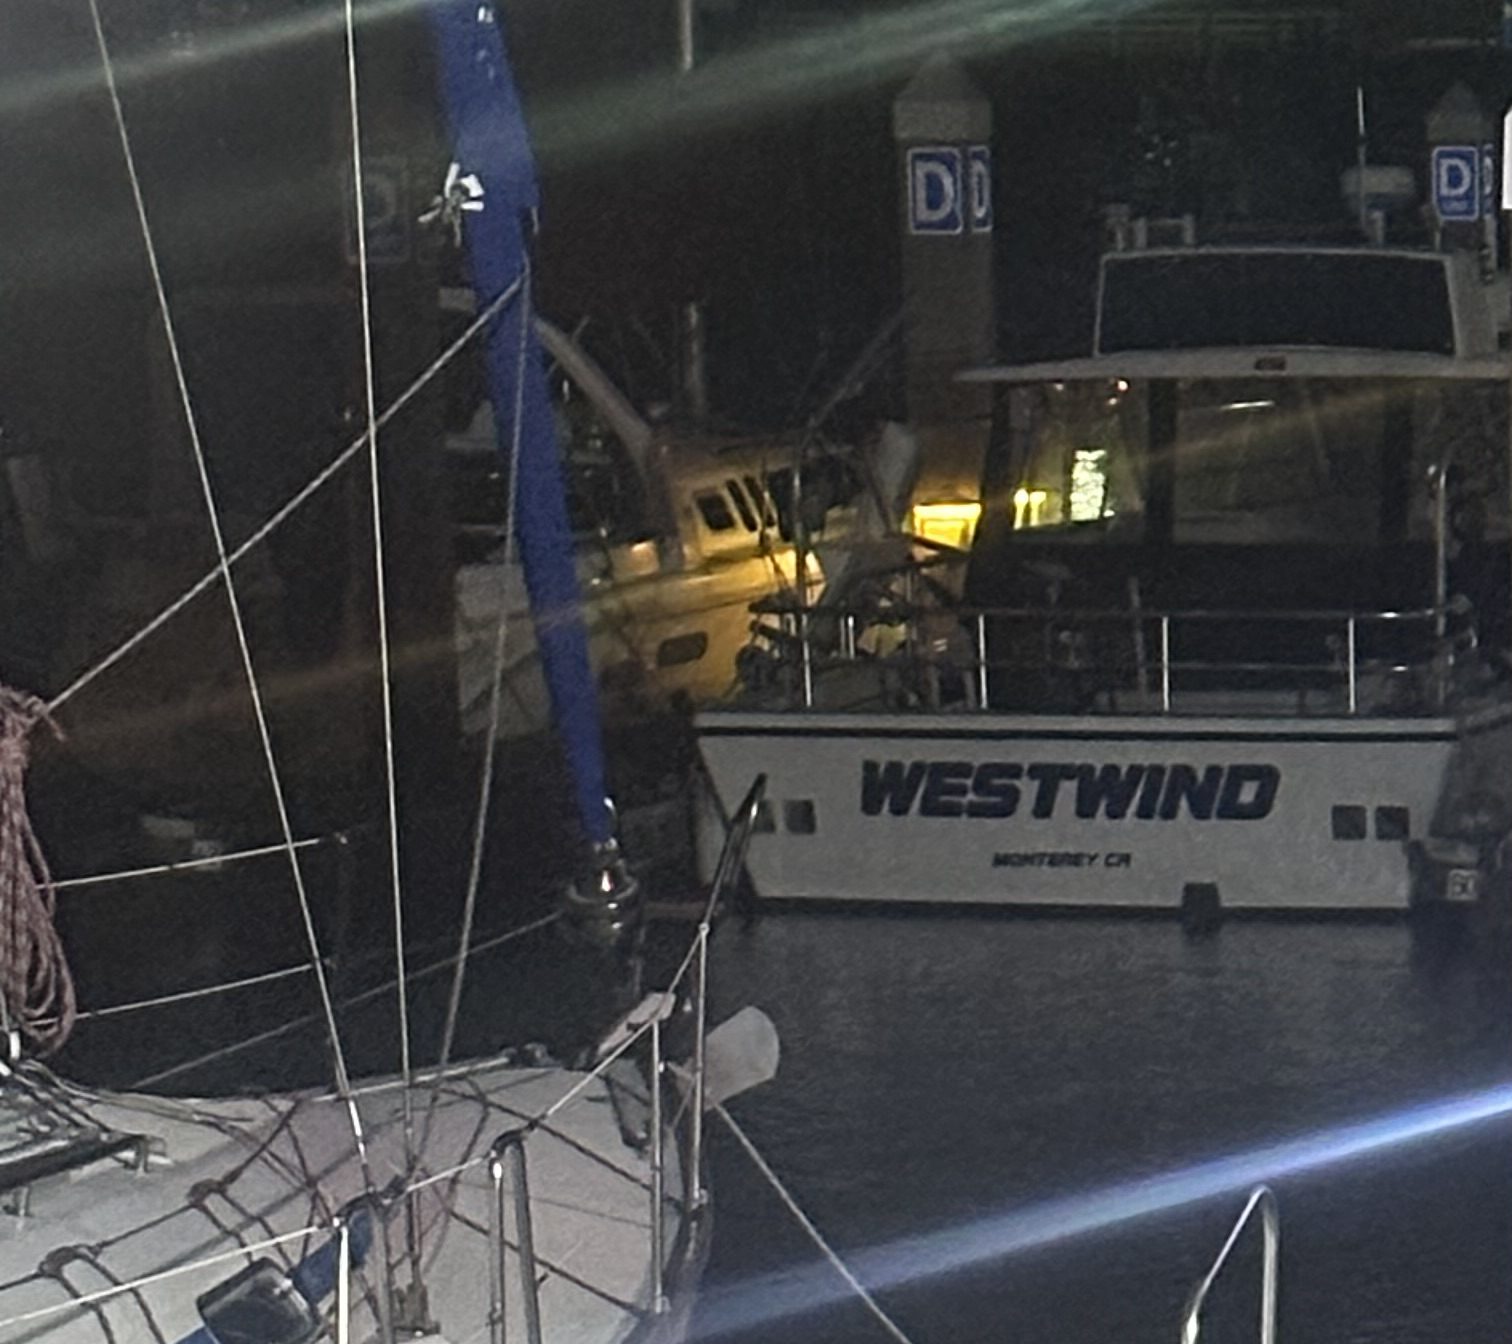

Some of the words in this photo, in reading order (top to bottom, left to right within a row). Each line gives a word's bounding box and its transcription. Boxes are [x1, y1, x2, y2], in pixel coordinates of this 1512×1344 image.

[915, 160, 955, 220] D
[1439, 158, 1471, 196] D
[860, 759, 1281, 820] WESTWIND
[992, 852, 1098, 868] MONTEREY
